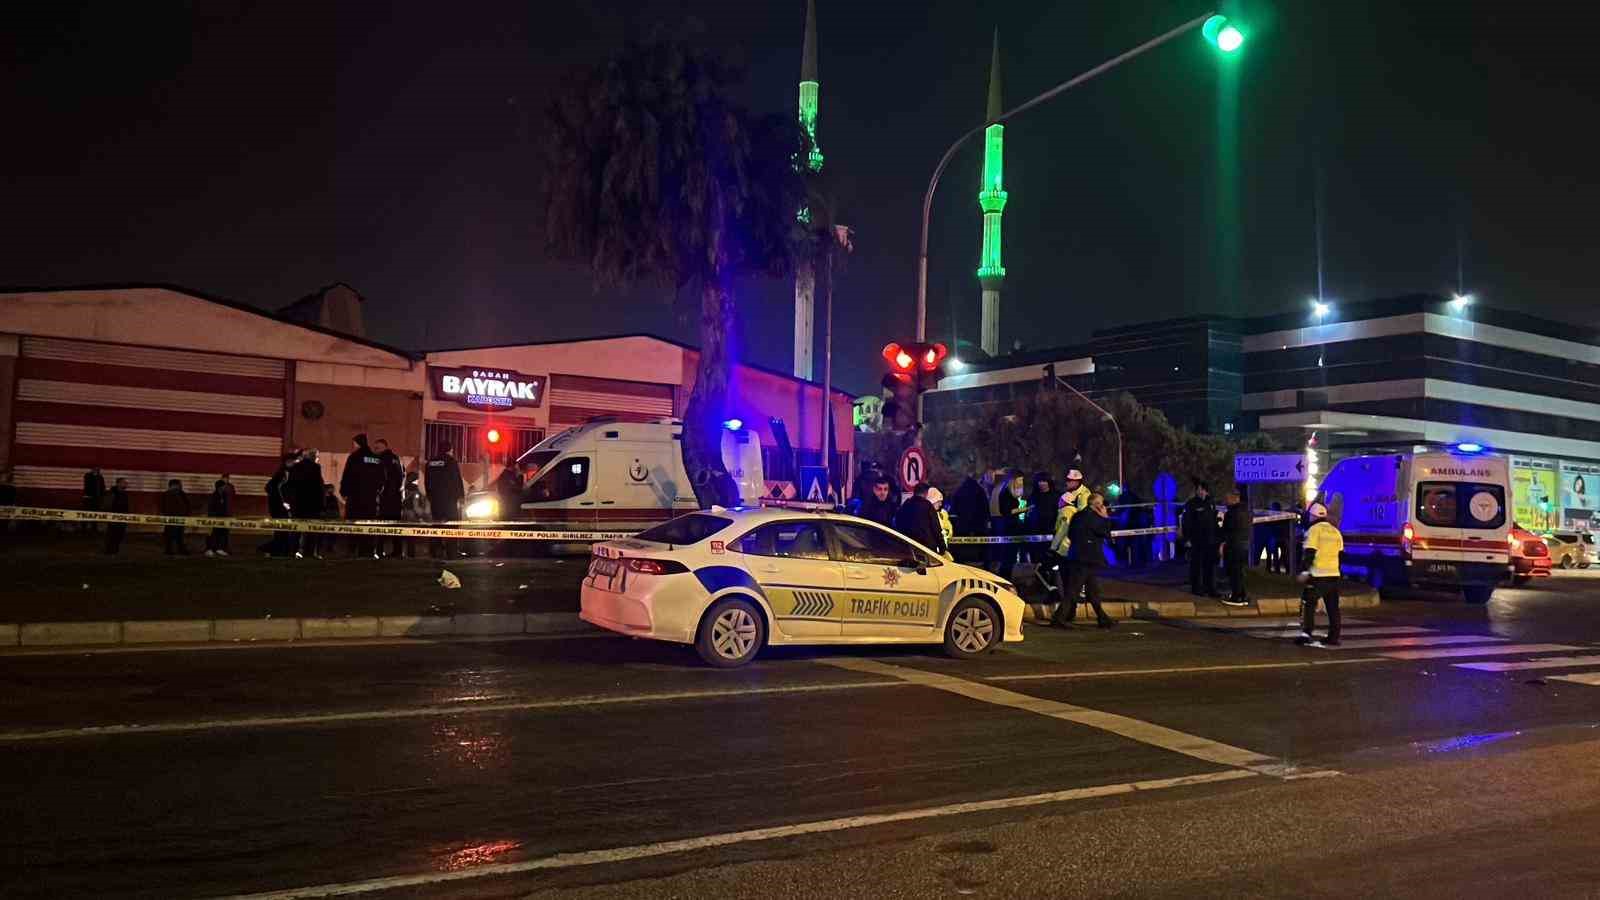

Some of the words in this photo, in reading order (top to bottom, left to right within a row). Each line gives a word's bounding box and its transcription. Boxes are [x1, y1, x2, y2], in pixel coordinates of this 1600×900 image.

[442, 375, 537, 399] BAYRAK
[1430, 467, 1491, 477] AMBULANS
[851, 597, 891, 616] TRAFİK
[894, 599, 929, 617] POLİSİ
